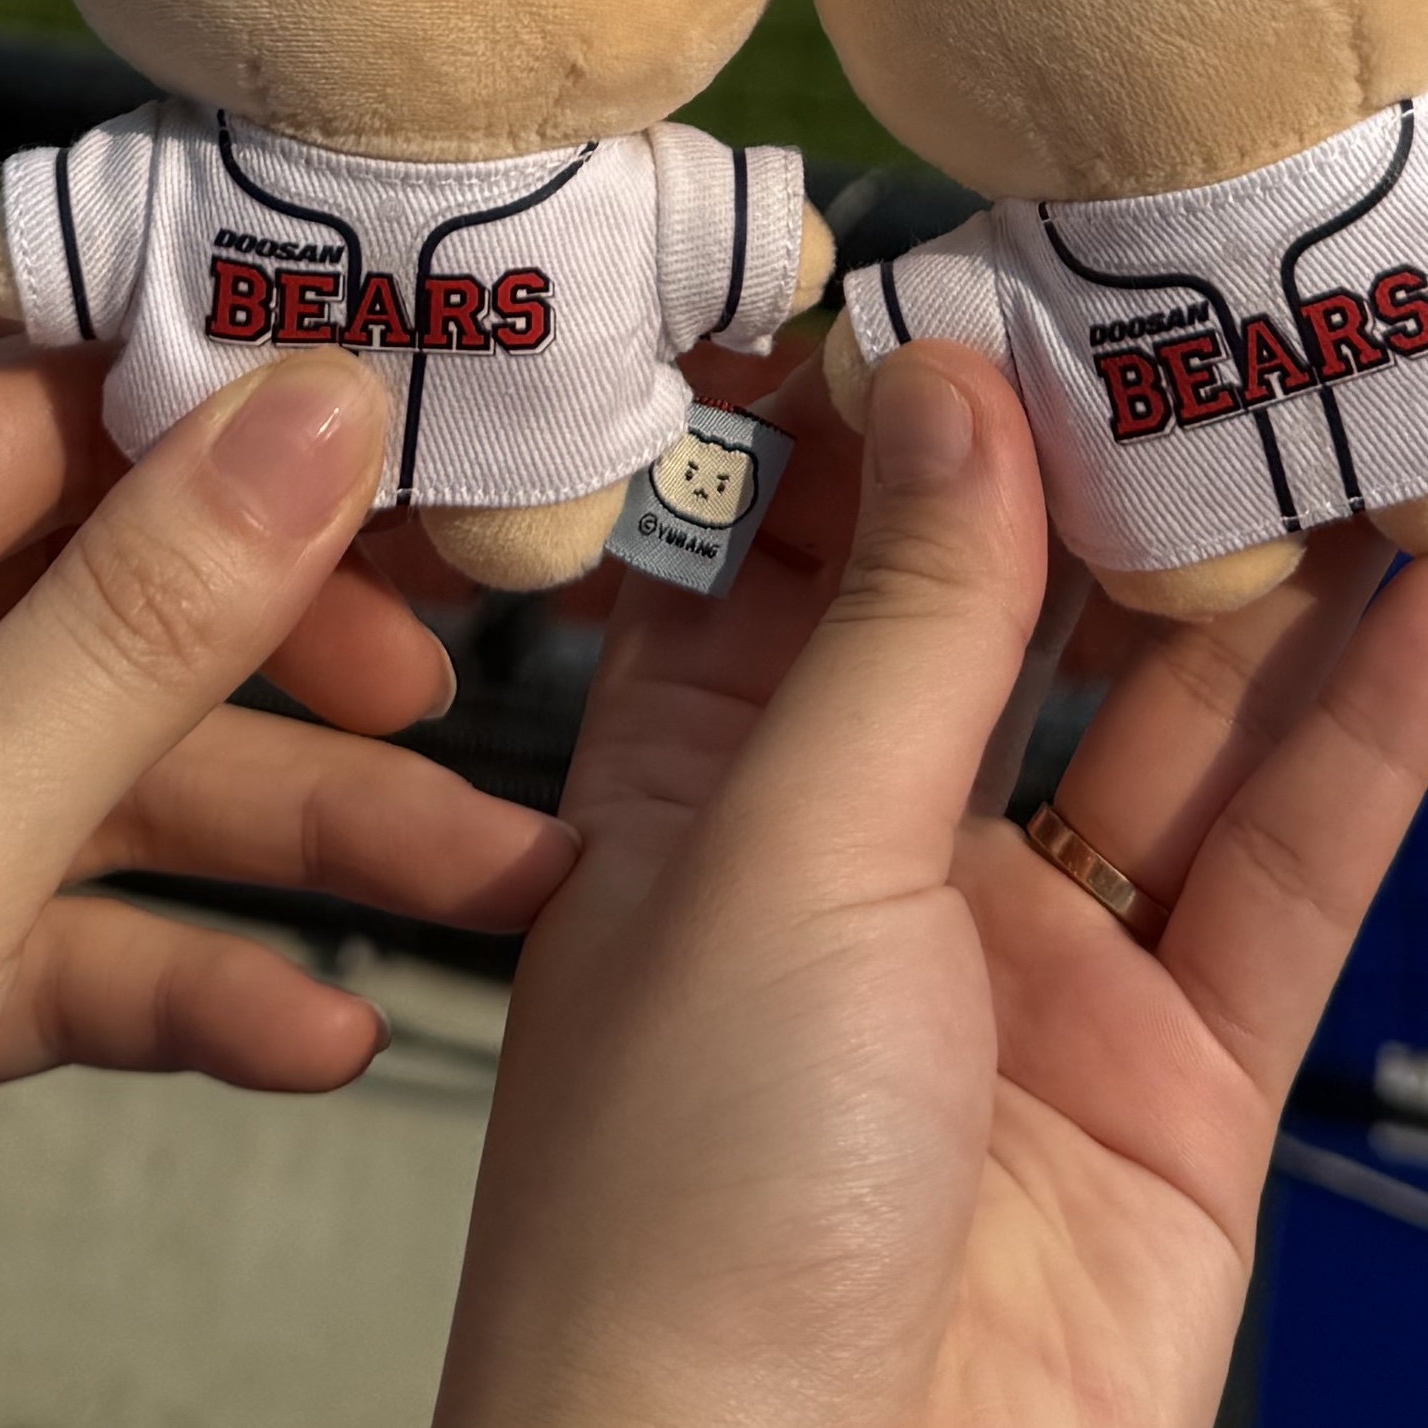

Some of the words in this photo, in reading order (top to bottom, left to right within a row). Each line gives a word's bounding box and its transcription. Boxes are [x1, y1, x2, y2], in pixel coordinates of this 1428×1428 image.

[213, 228, 346, 265] DOOSAN
[206, 255, 557, 357] BEARS
[1088, 300, 1211, 347] DOOSAN
